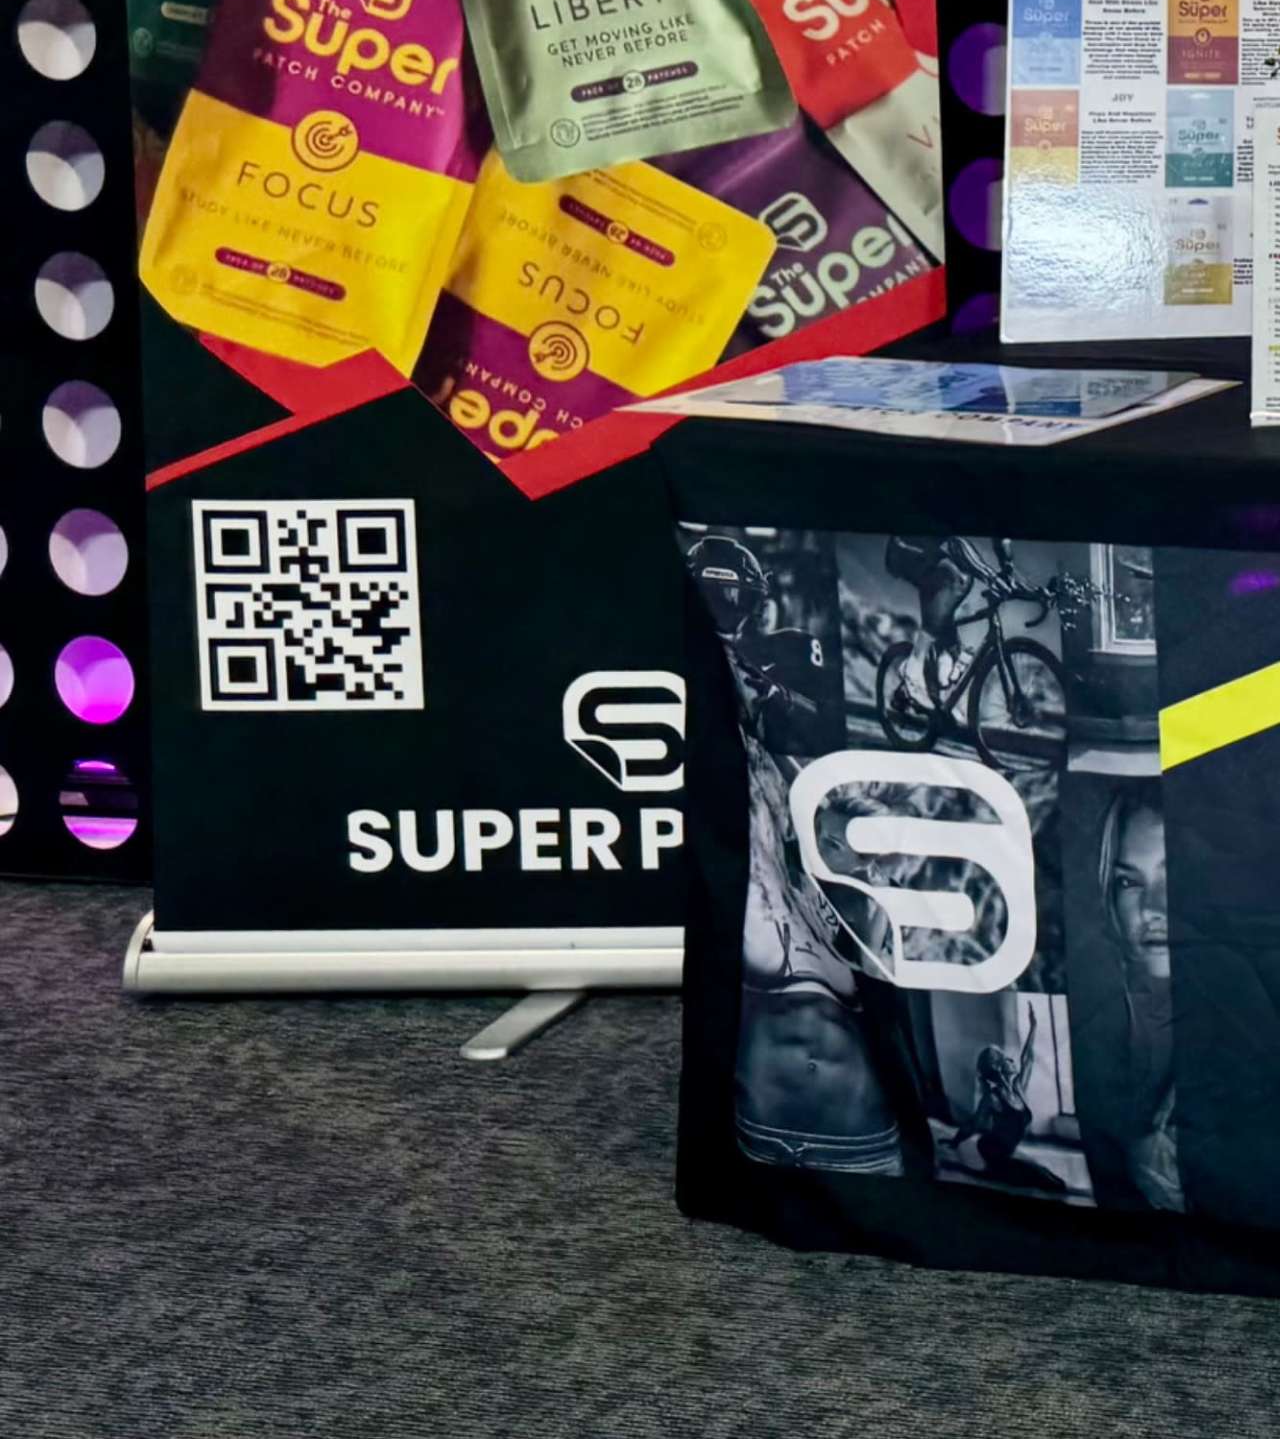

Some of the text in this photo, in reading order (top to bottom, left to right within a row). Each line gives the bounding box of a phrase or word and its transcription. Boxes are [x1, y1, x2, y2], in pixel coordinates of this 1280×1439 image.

[547, 12, 696, 56] GET MOVING LIKE
[561, 30, 689, 67] NEVER BEFORE
[825, 18, 887, 67] PATCH
[236, 160, 383, 229] FOCUS
[770, 262, 805, 286] The
[518, 261, 645, 347] FOCUS
[810, 638, 823, 666] 8
[346, 808, 623, 873] SUPER
